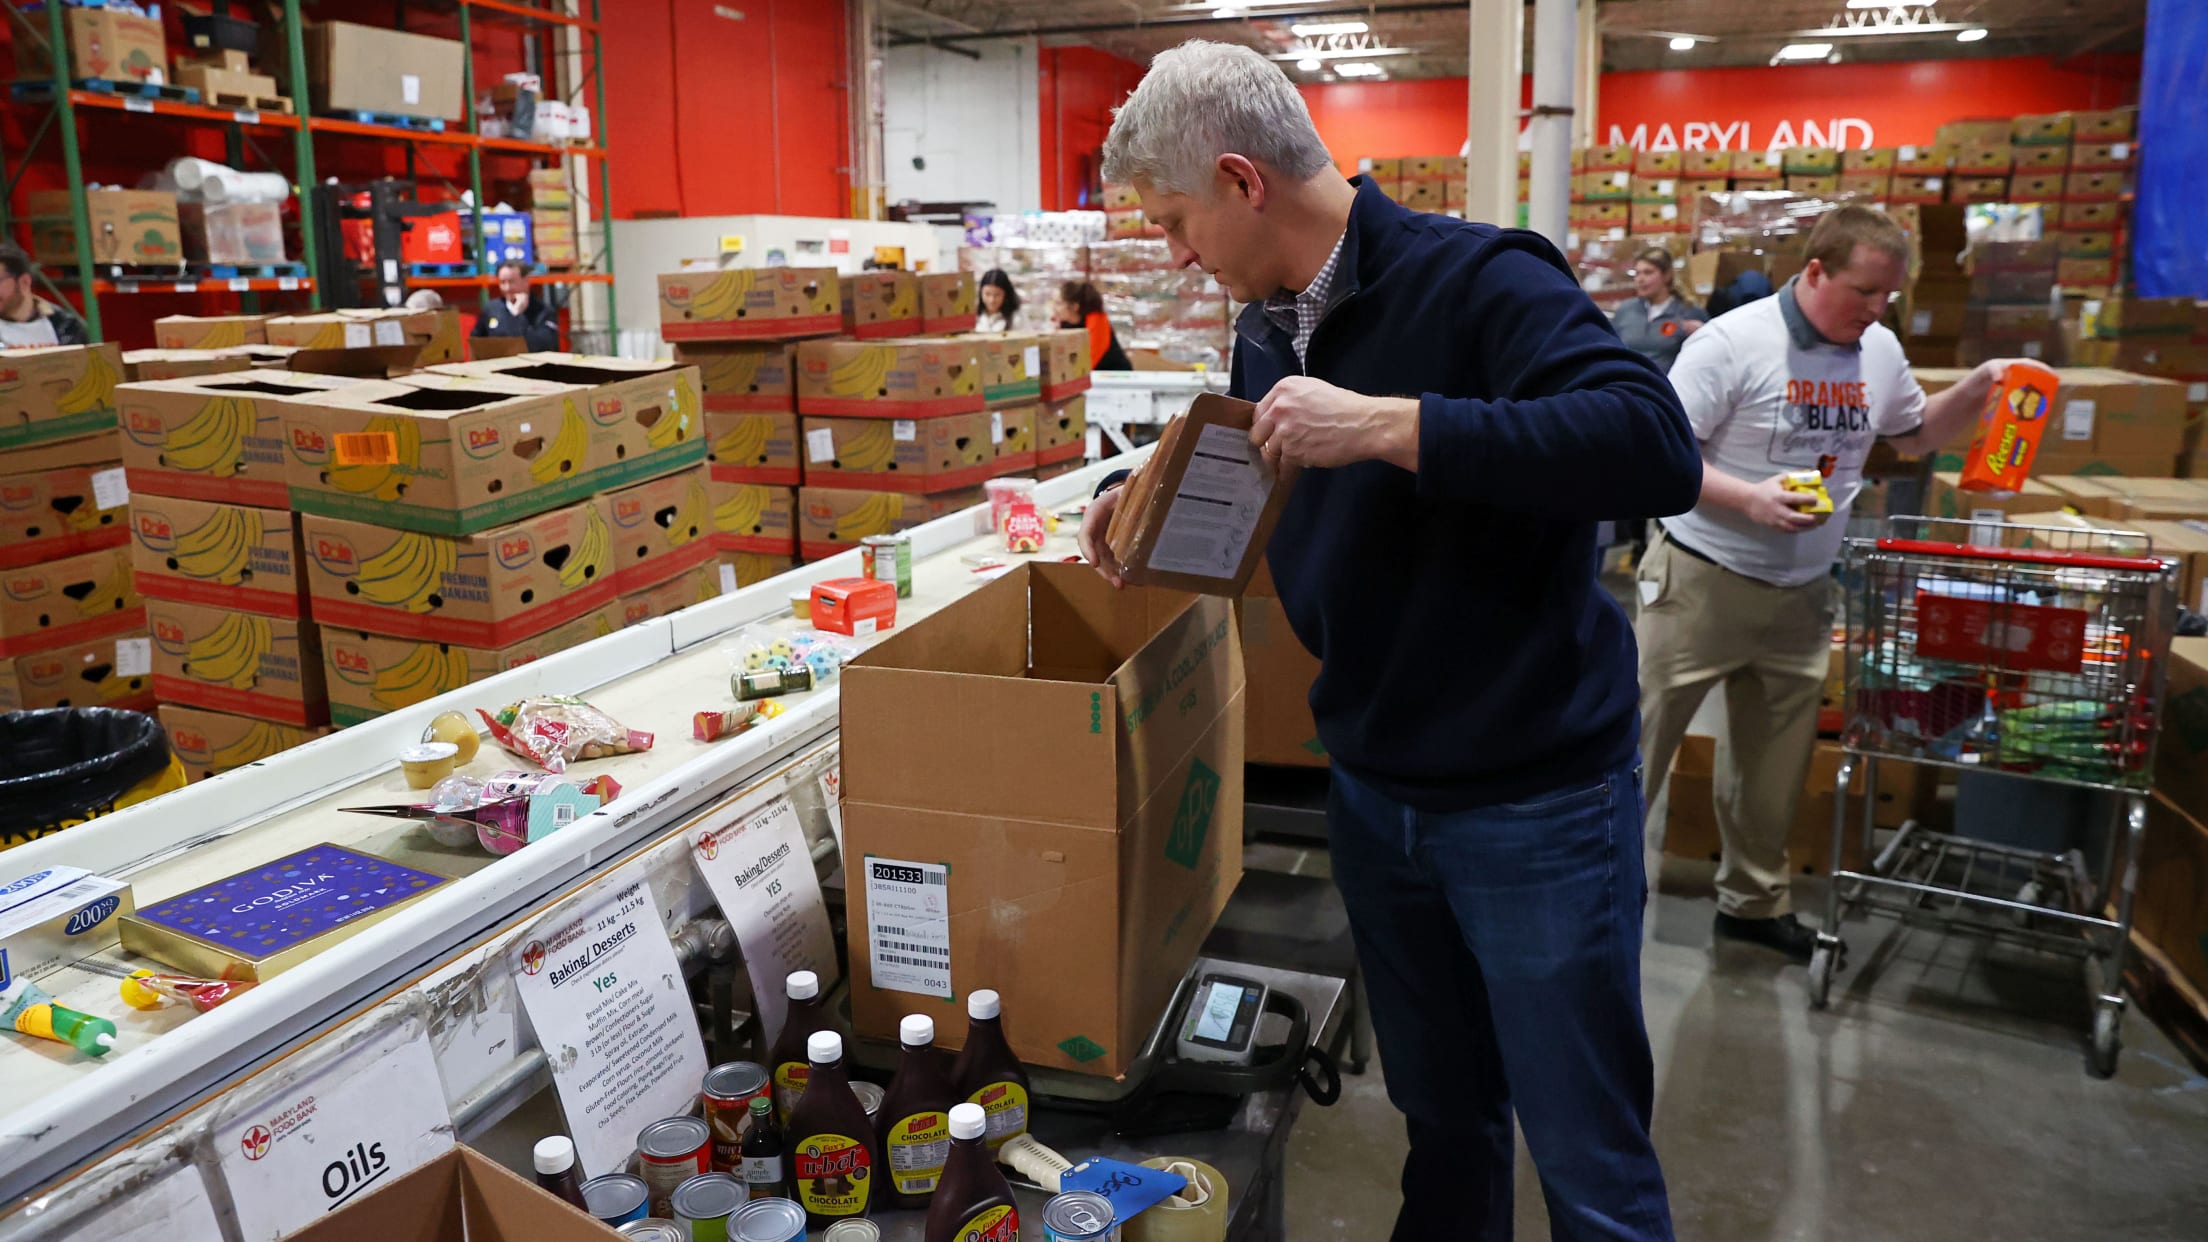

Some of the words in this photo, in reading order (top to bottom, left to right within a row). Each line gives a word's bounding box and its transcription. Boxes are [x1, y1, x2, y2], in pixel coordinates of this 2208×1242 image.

[1609, 118, 1874, 152] MARYLAND
[1786, 378, 1869, 408] ORANGE
[597, 398, 622, 417] Dole
[1807, 404, 1871, 431] BLACK
[294, 428, 325, 450] Dole
[469, 427, 499, 446] Dole
[141, 517, 171, 537] Dole
[319, 540, 353, 562] Dole
[502, 538, 530, 558] Dole
[440, 571, 488, 588] PREMIUM
[440, 587, 490, 603] BANANAS
[336, 648, 369, 670] Dole
[734, 841, 790, 887] Baking/Desserts
[875, 866, 922, 883] 201533
[232, 872, 336, 914] GODIVA
[275, 888, 328, 910] GOLDMARK
[616, 882, 641, 903] Weight
[765, 878, 783, 899] YES
[71, 904, 102, 933] 200
[606, 914, 617, 926] kg
[620, 902, 636, 917] 11.5
[635, 895, 645, 908] kg
[549, 946, 592, 986] Baking/
[592, 921, 637, 957] Desserts
[593, 971, 618, 994] Yes
[924, 978, 947, 989] 0043
[585, 1003, 603, 1021] Bread
[588, 1016, 607, 1033] Muffin
[618, 997, 632, 1010] Corn
[269, 1095, 315, 1128] MARYLAND
[984, 1097, 1015, 1112] OCOLATE
[272, 1117, 296, 1137] FOOD
[296, 1103, 318, 1122] BANK
[901, 1128, 947, 1142] CHOCOLATE
[823, 1142, 846, 1153] Fox's
[322, 1141, 386, 1199] Oils
[805, 1148, 862, 1175] u-bet
[808, 1195, 859, 1206] CHOCOLATE
